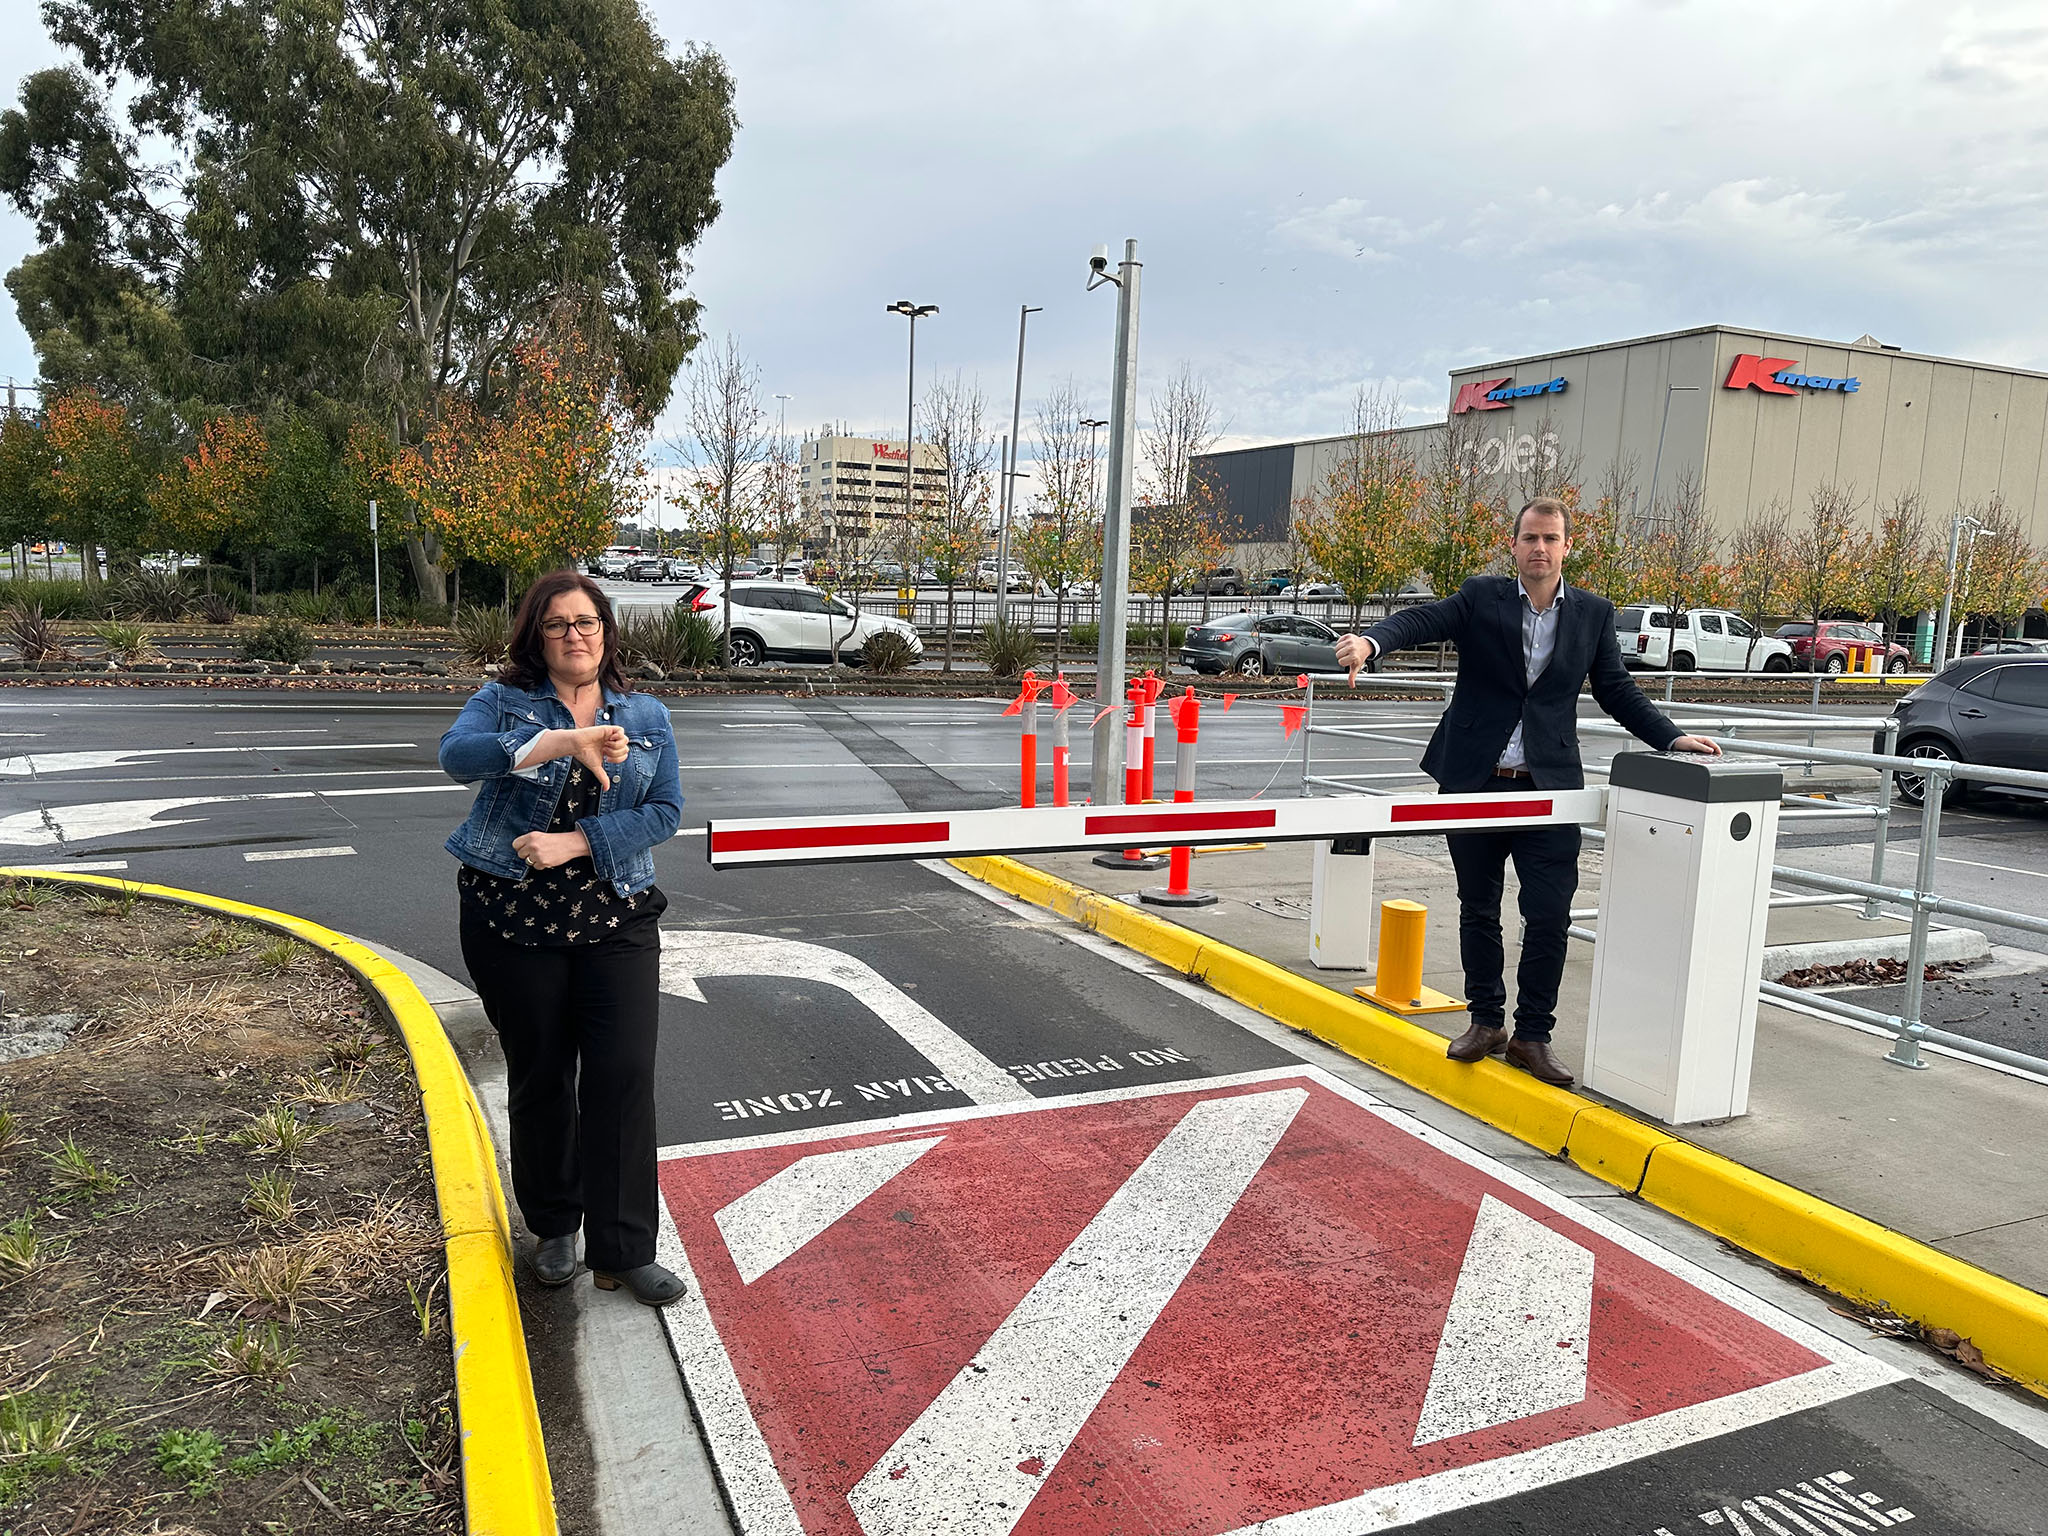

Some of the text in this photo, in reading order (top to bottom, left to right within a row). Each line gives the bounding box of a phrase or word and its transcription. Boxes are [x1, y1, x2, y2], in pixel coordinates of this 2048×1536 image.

[1723, 353, 1862, 396] Kmart
[1453, 376, 1568, 414] Kmart
[872, 443, 915, 461] Westfiel
[1128, 1047, 1190, 1067] NO
[713, 1087, 844, 1121] ZONE
